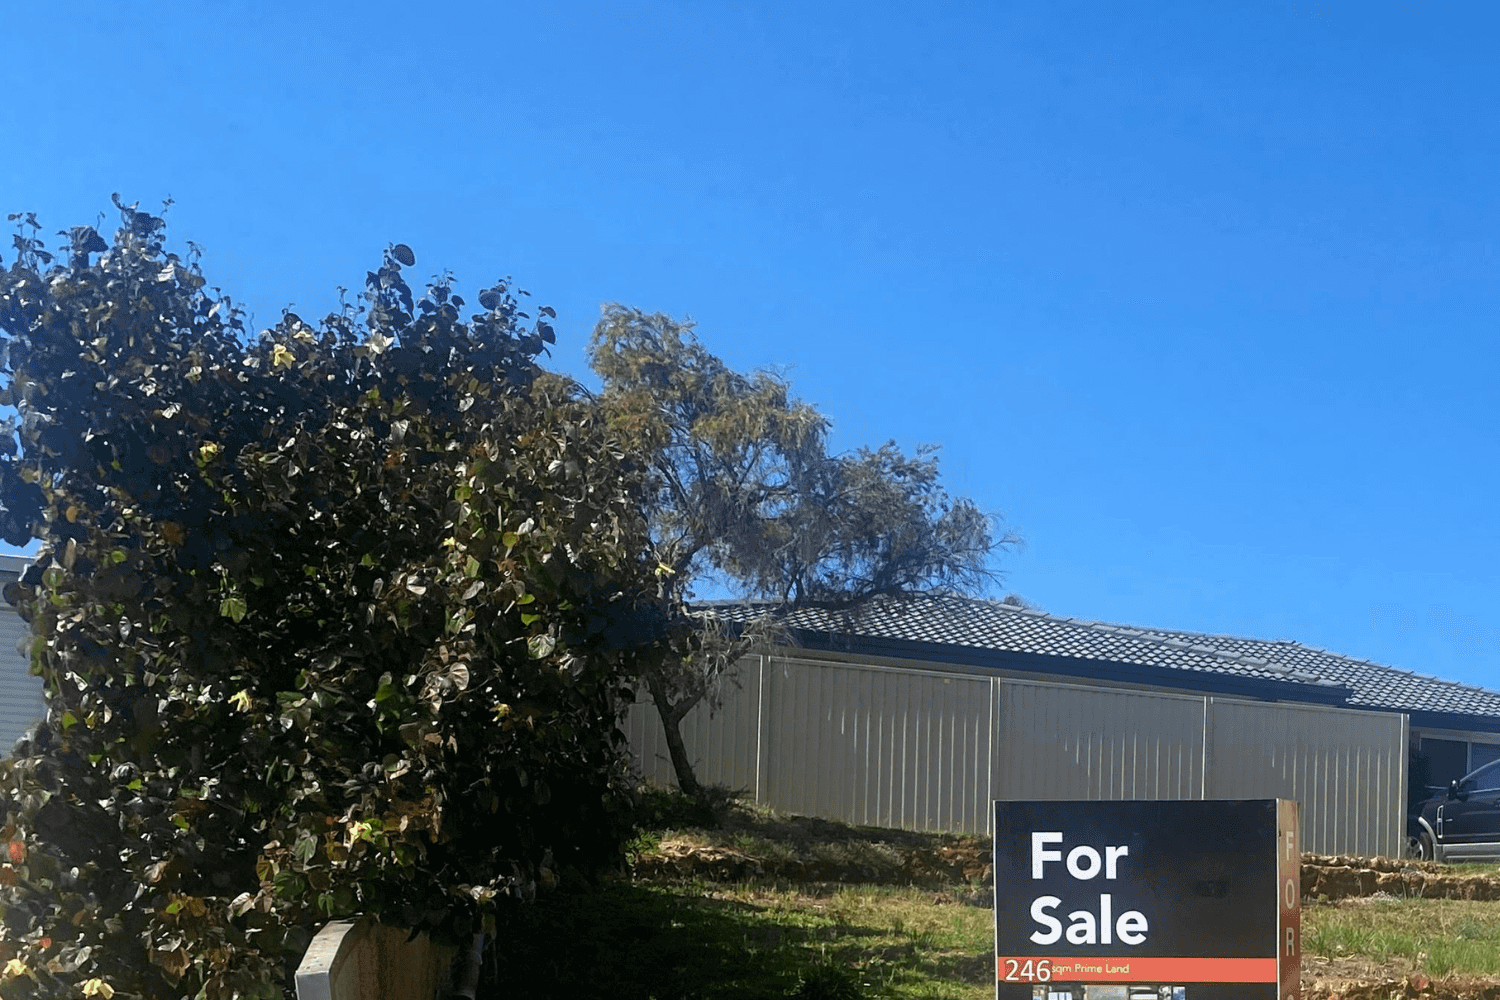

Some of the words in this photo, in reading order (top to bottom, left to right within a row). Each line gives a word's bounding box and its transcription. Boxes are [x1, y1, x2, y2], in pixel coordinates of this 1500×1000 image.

[1031, 831, 1129, 881] For
[1029, 893, 1149, 946] Sale
[1285, 831, 1296, 957] FOR
[1005, 959, 1051, 982] 246
[1052, 965, 1072, 976] sqm
[1074, 963, 1103, 974] Prime
[1105, 963, 1130, 974] Land
